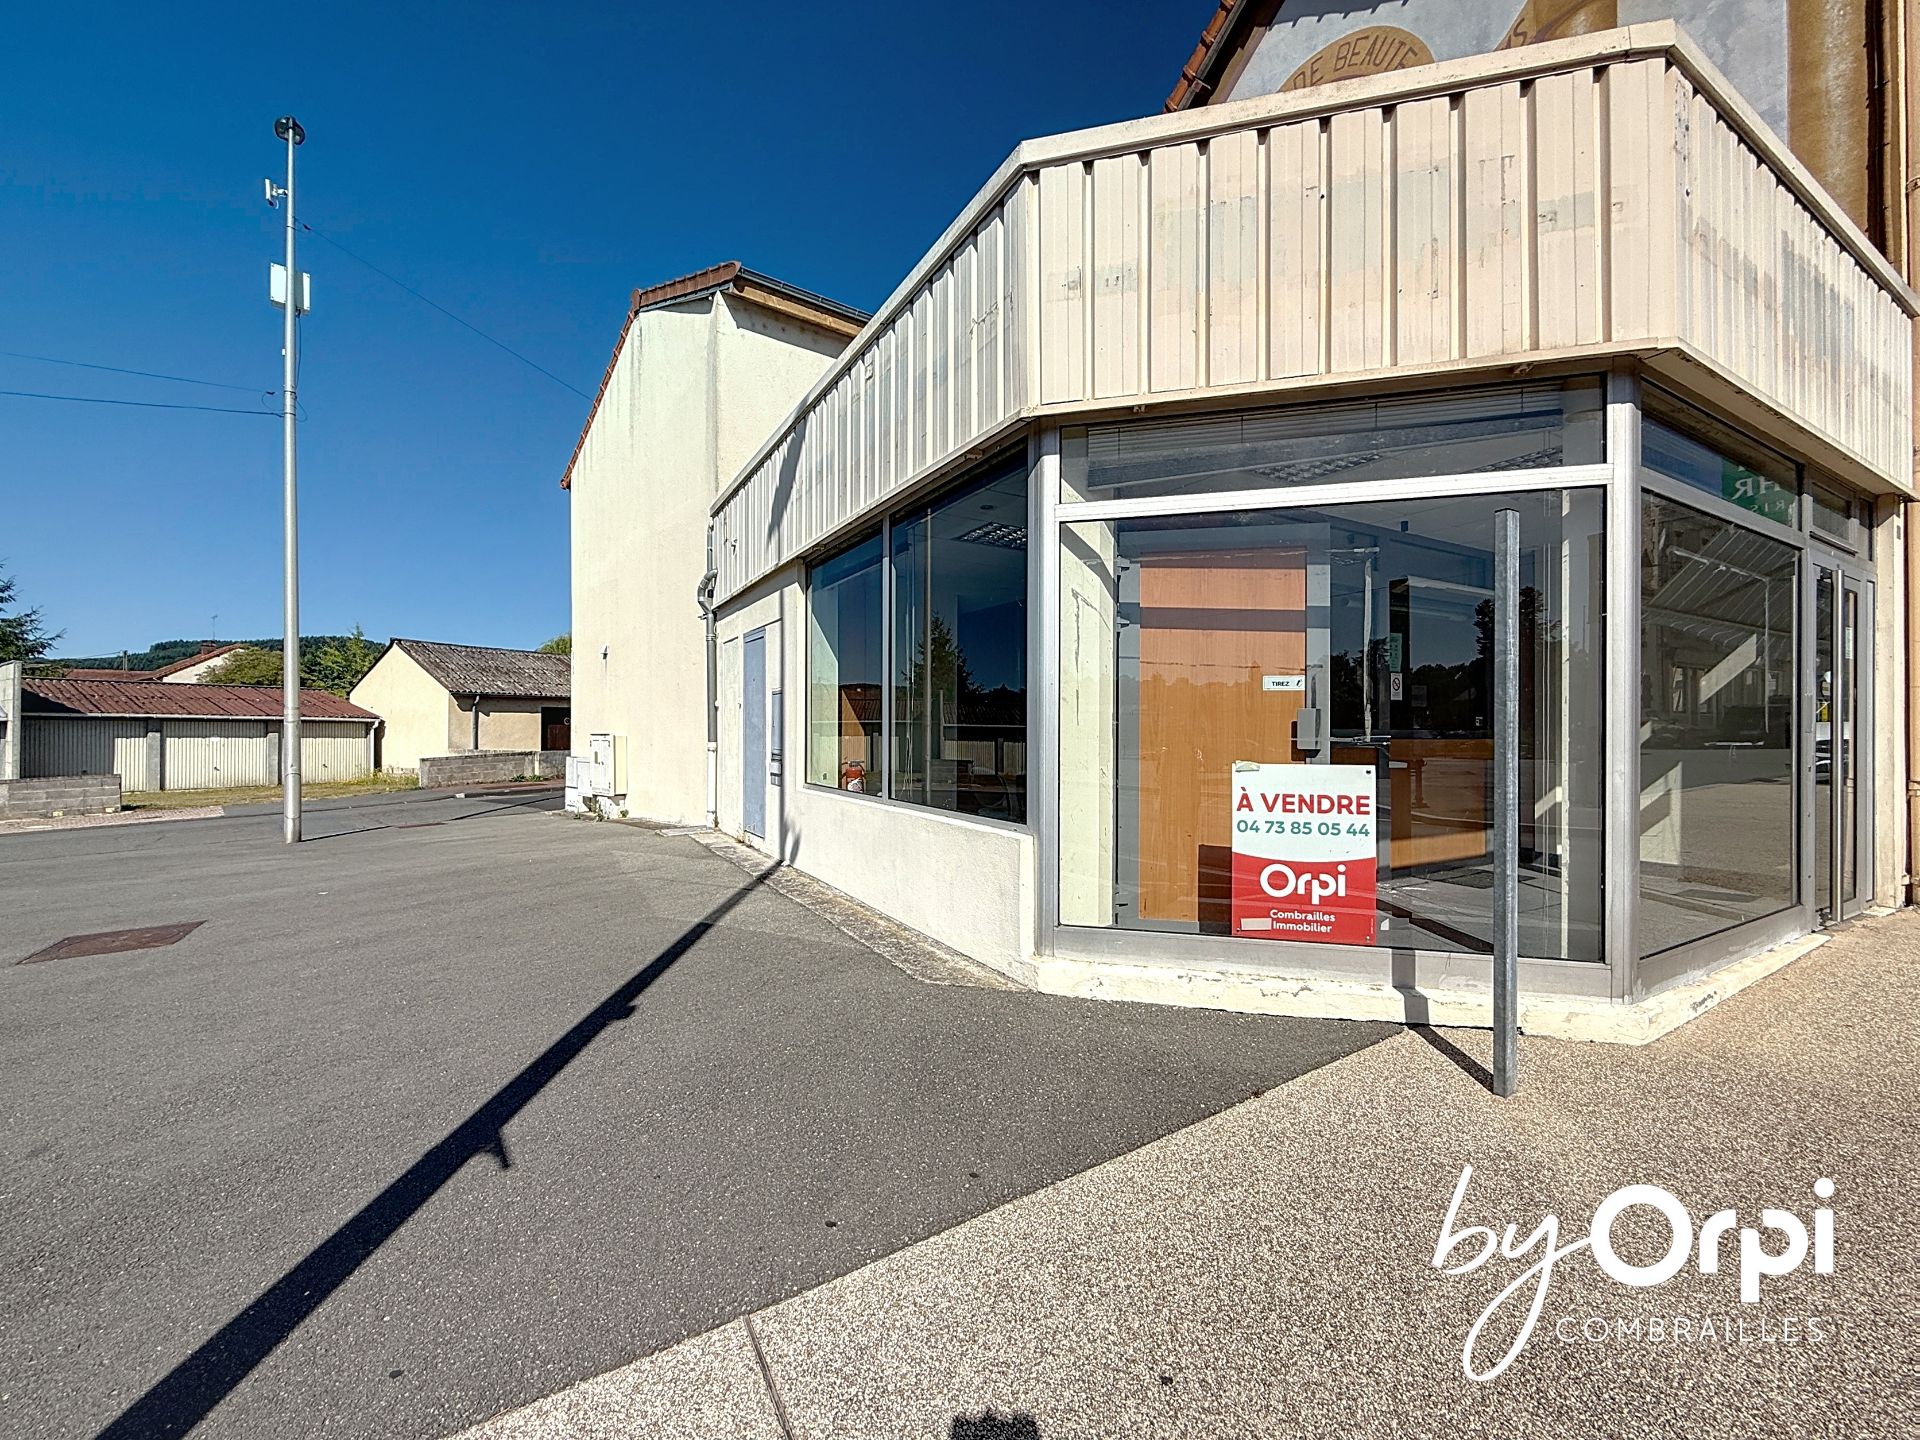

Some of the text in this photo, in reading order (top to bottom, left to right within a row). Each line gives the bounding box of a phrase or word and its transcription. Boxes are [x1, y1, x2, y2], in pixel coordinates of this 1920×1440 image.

[1236, 787, 1371, 815] À VENDRE
[1236, 820, 1370, 837] 04 73 85 05 44
[1259, 863, 1346, 905] Orpi
[1269, 909, 1336, 922] Combrailles
[1273, 922, 1332, 933] Immobilier
